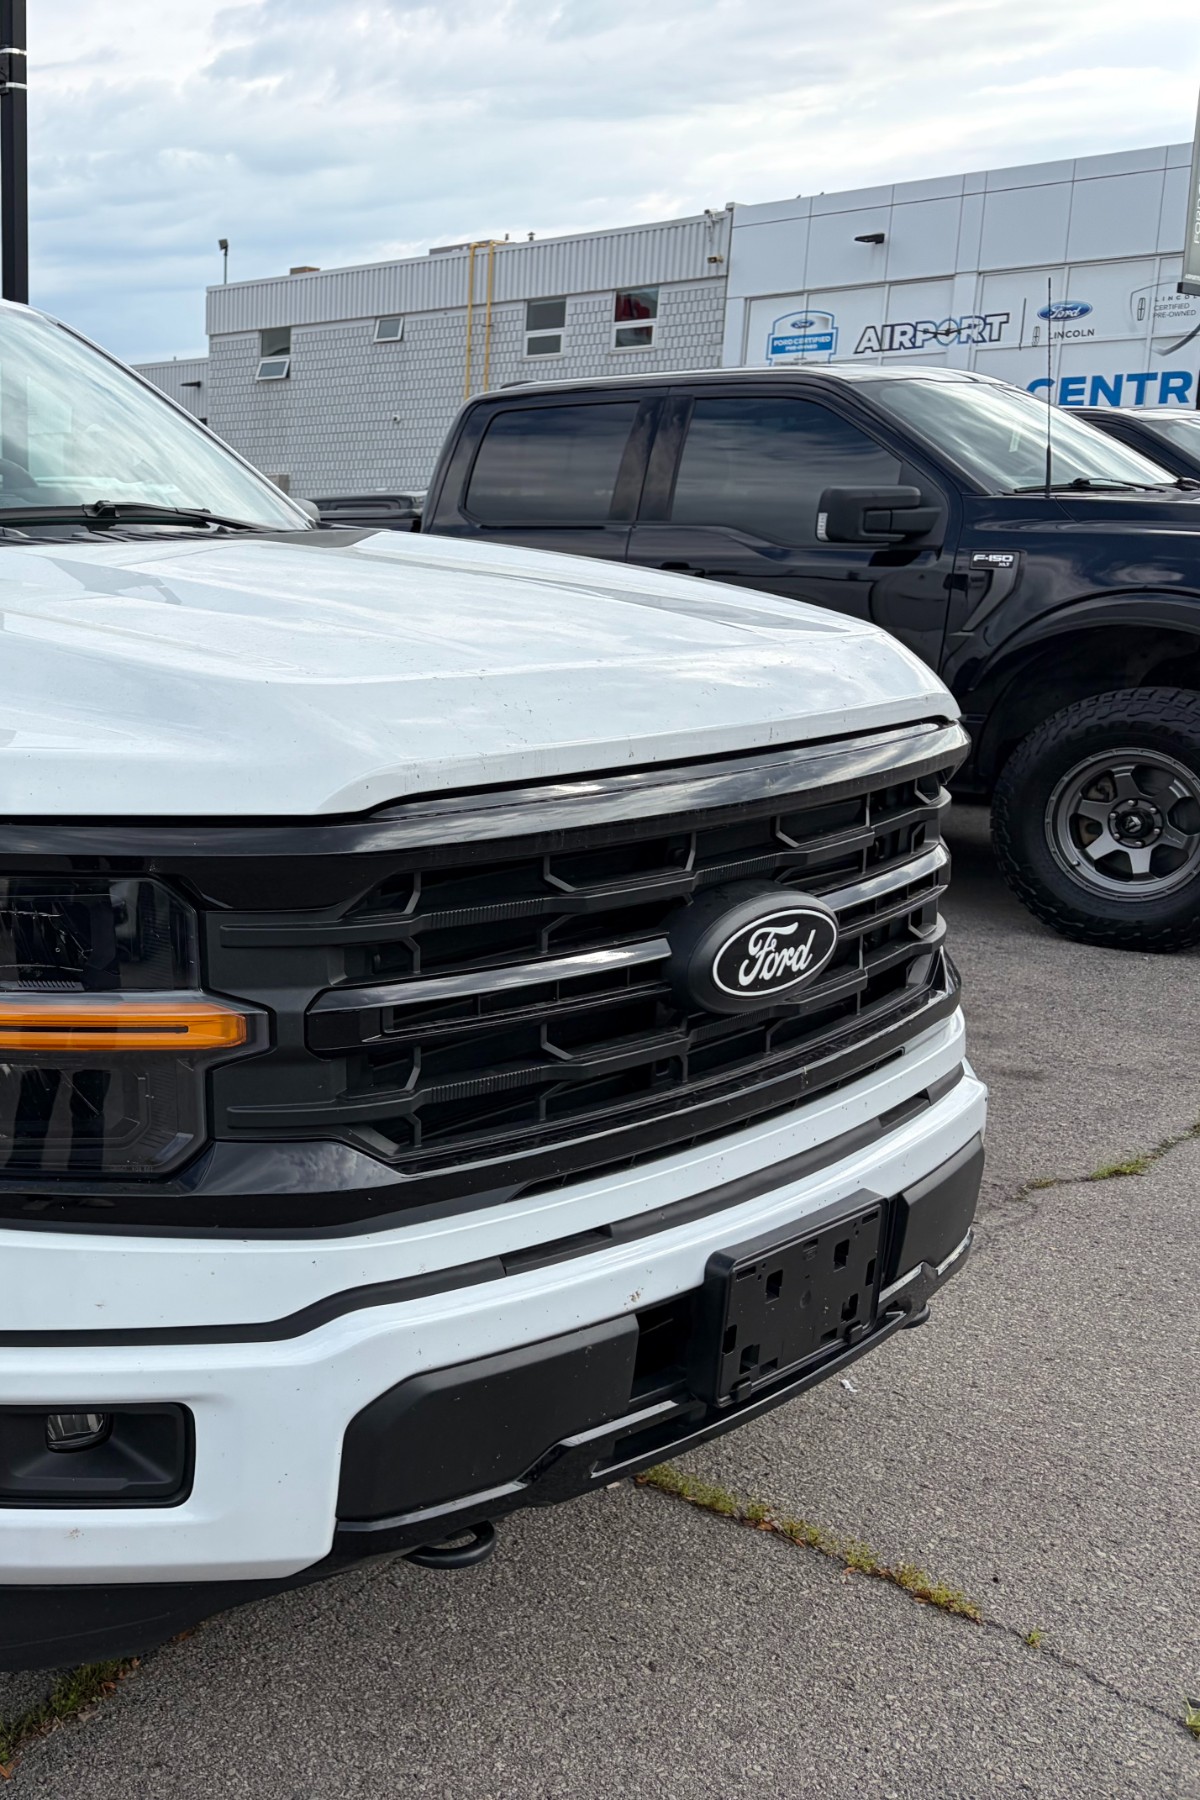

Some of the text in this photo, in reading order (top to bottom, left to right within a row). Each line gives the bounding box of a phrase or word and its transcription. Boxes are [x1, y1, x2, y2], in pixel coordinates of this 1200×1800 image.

[1047, 304, 1082, 319] Ford
[1154, 303, 1191, 312] CERTIFIED
[1153, 309, 1197, 319] PRE-OWNED
[853, 312, 1010, 354] AIRPORT
[1049, 328, 1096, 340] LINCOLN
[774, 335, 831, 347] FORD CERTIFIED
[973, 554, 1014, 563] F-150
[738, 921, 817, 987] Ford
